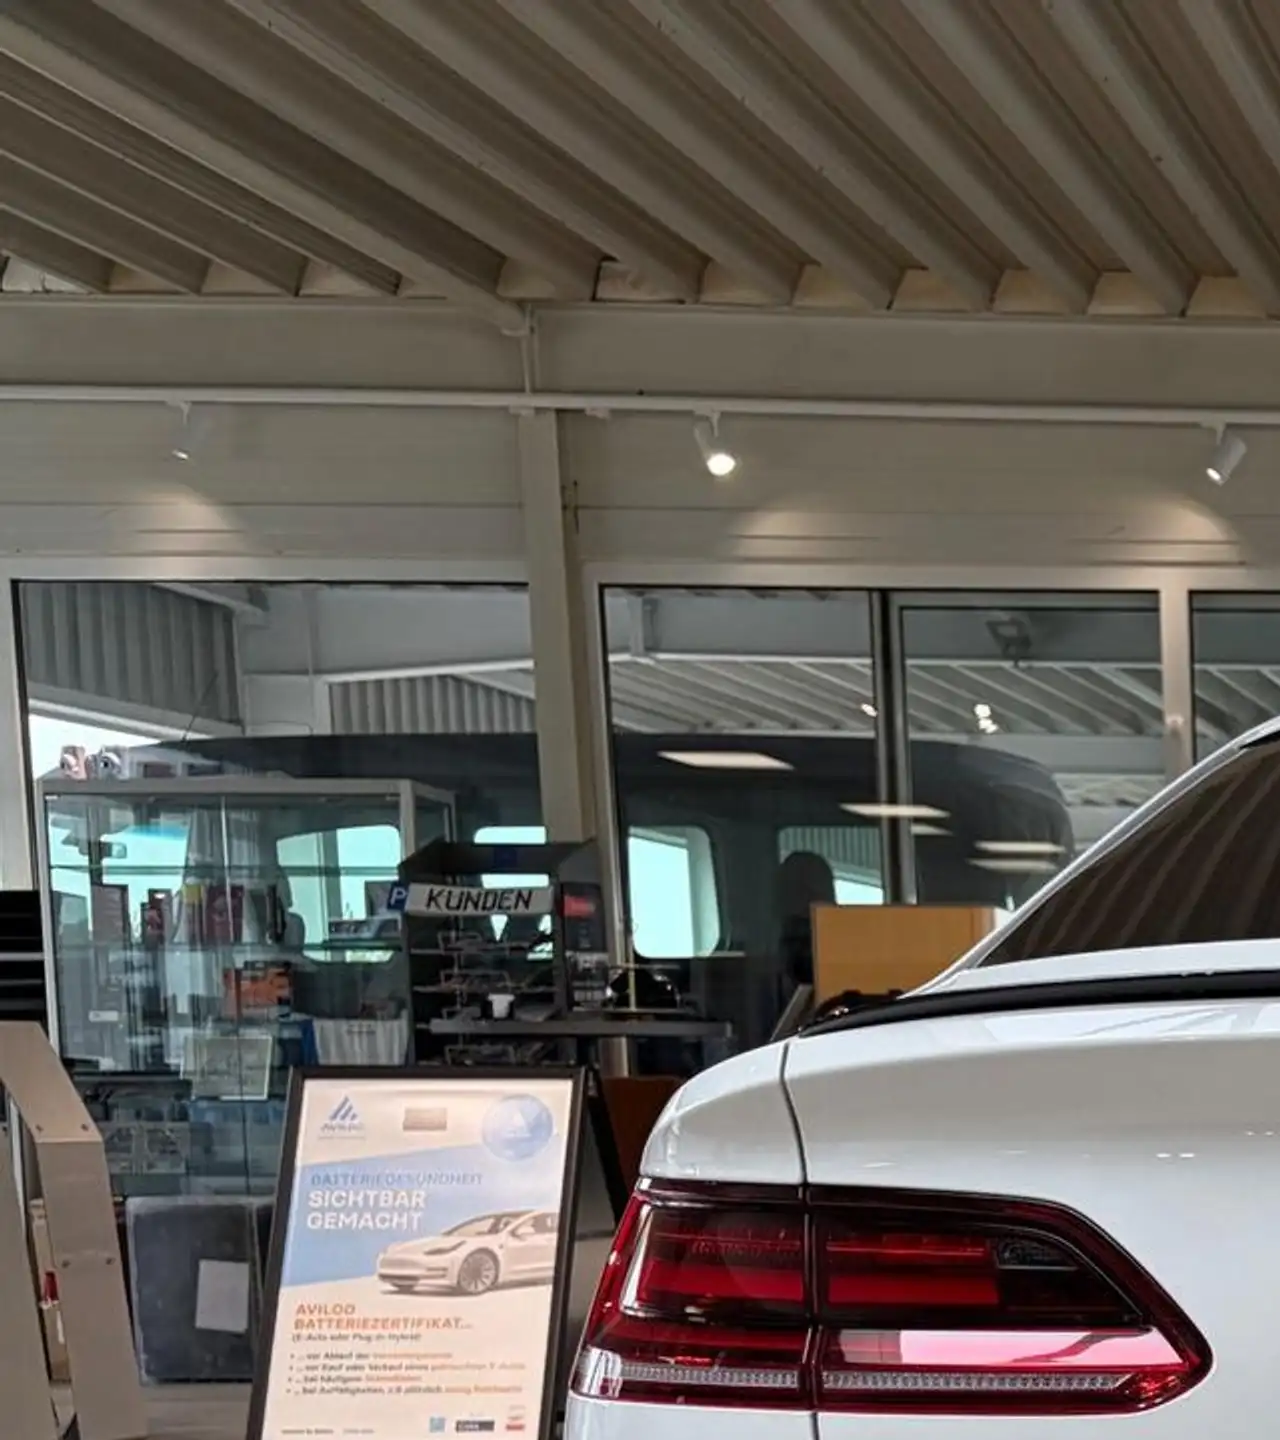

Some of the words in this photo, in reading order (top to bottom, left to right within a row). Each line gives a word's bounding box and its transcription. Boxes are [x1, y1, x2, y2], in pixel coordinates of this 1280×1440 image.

[426, 887, 534, 912] KUNDEN
[308, 1189, 426, 1209] SICHTBAR
[306, 1211, 422, 1230] GEMACHT
